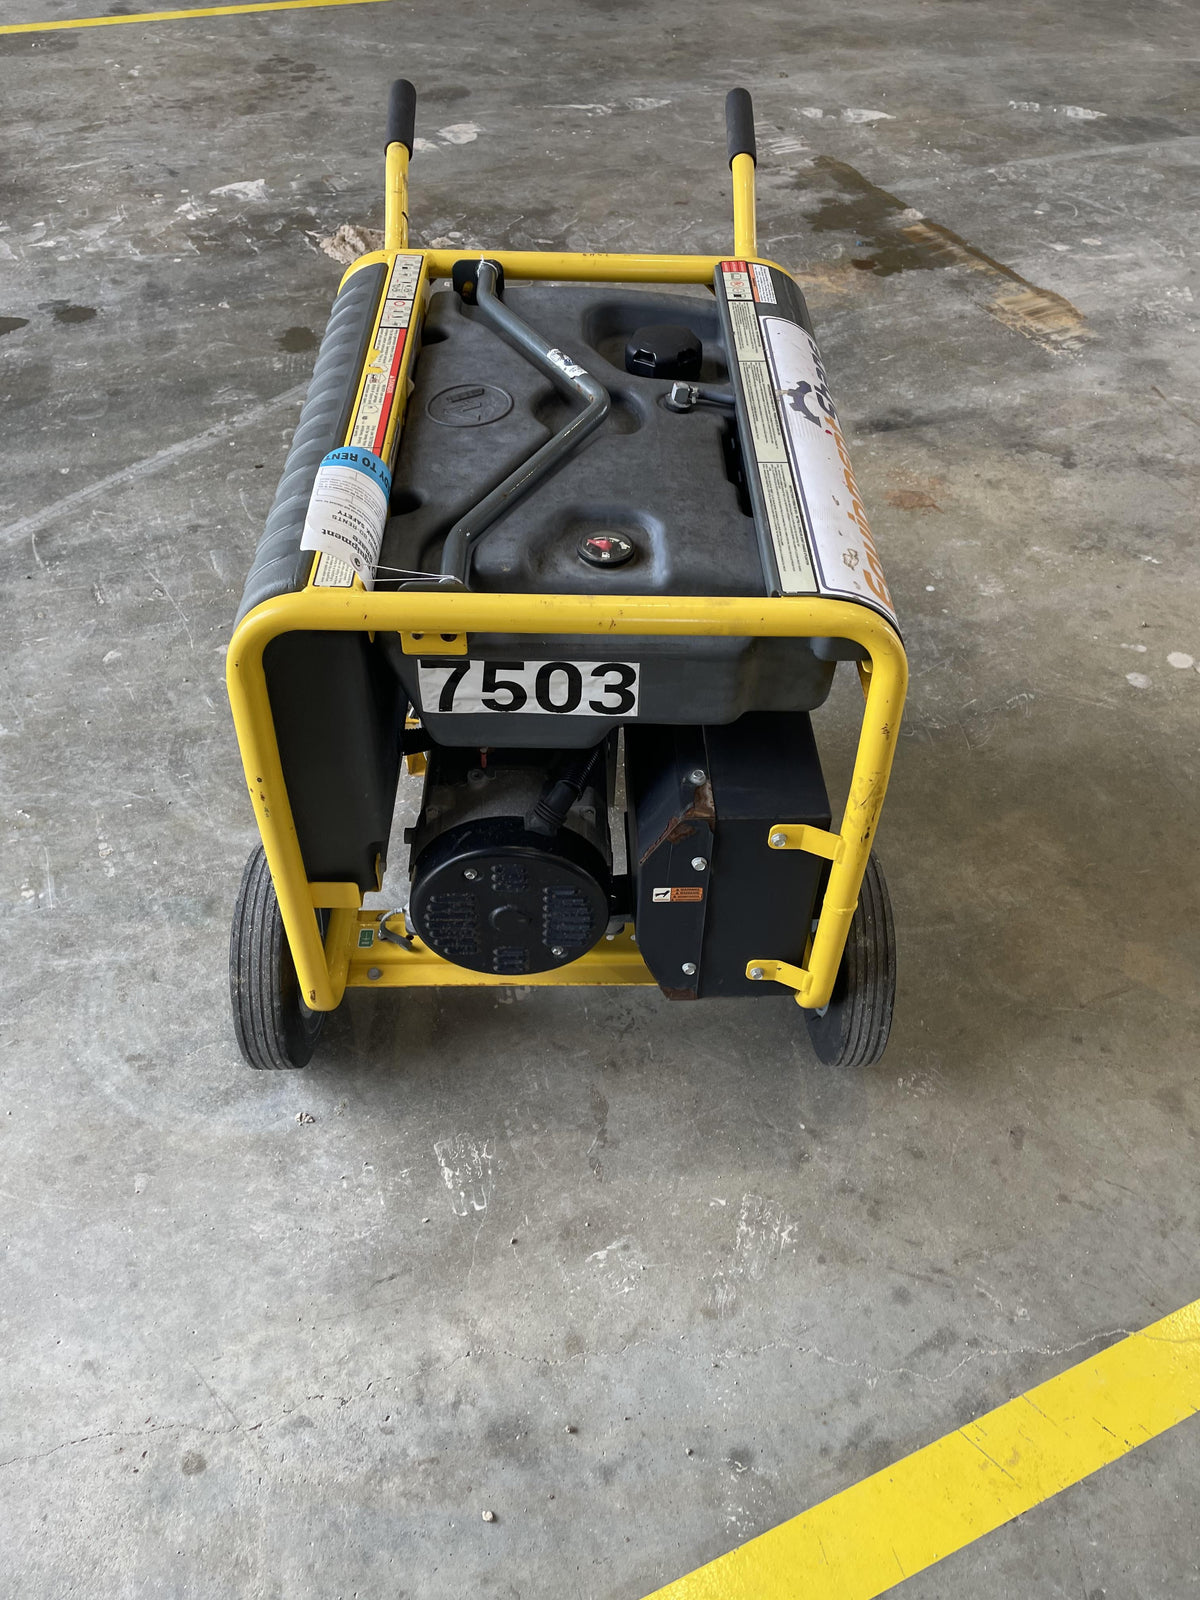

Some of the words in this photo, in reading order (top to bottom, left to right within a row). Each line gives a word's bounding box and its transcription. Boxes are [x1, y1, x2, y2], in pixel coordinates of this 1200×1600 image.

[362, 456, 377, 473] TO
[337, 510, 365, 529] SAFETY
[420, 660, 637, 715] 7503
